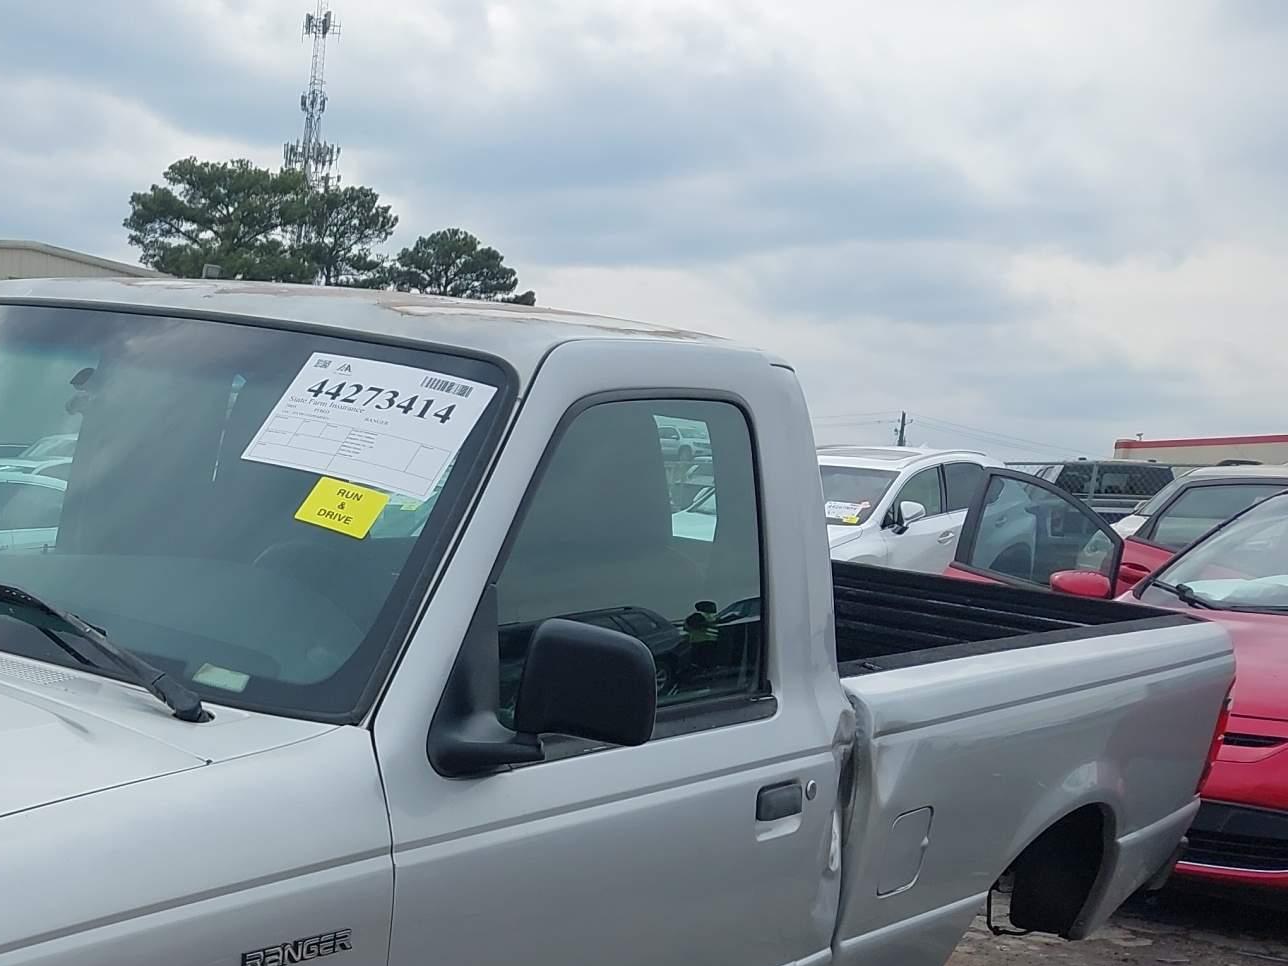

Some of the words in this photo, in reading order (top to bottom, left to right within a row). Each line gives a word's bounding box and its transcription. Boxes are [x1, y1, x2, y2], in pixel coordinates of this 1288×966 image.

[289, 396, 308, 404] State
[309, 398, 328, 408] Farm
[328, 401, 366, 414] Insurance
[307, 378, 457, 424] 44273414
[336, 488, 364, 501] RUN
[337, 501, 346, 510] &
[316, 508, 353, 525] DRIVE
